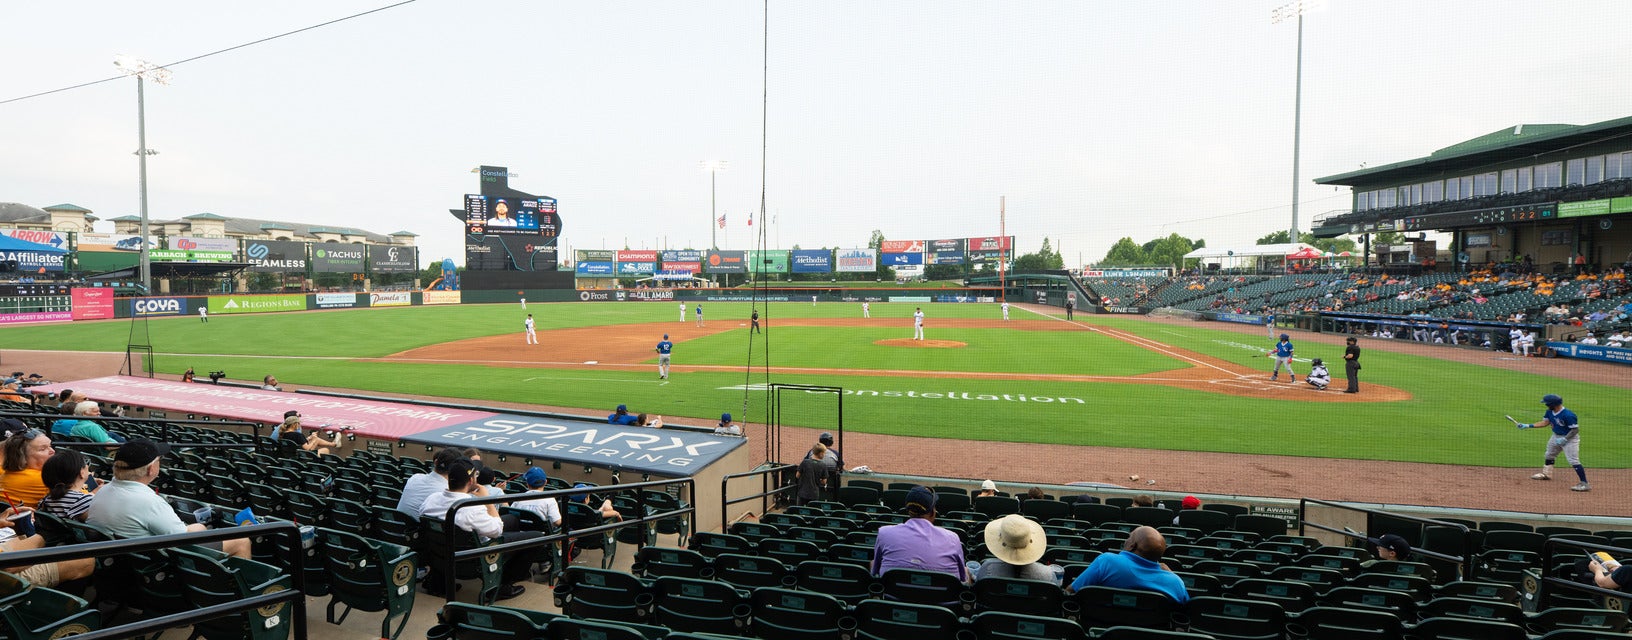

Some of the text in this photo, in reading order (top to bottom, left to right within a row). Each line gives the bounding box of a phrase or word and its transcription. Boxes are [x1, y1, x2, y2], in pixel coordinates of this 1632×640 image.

[328, 250, 361, 259] TACHUS
[248, 259, 305, 268] SEAMLESS
[242, 300, 282, 308] REGIONS
[371, 294, 399, 305] Pamela
[135, 300, 180, 312] GOYA
[386, 406, 462, 421] PARK
[466, 419, 722, 456] SPARX
[442, 430, 694, 467] ENGINEERING
